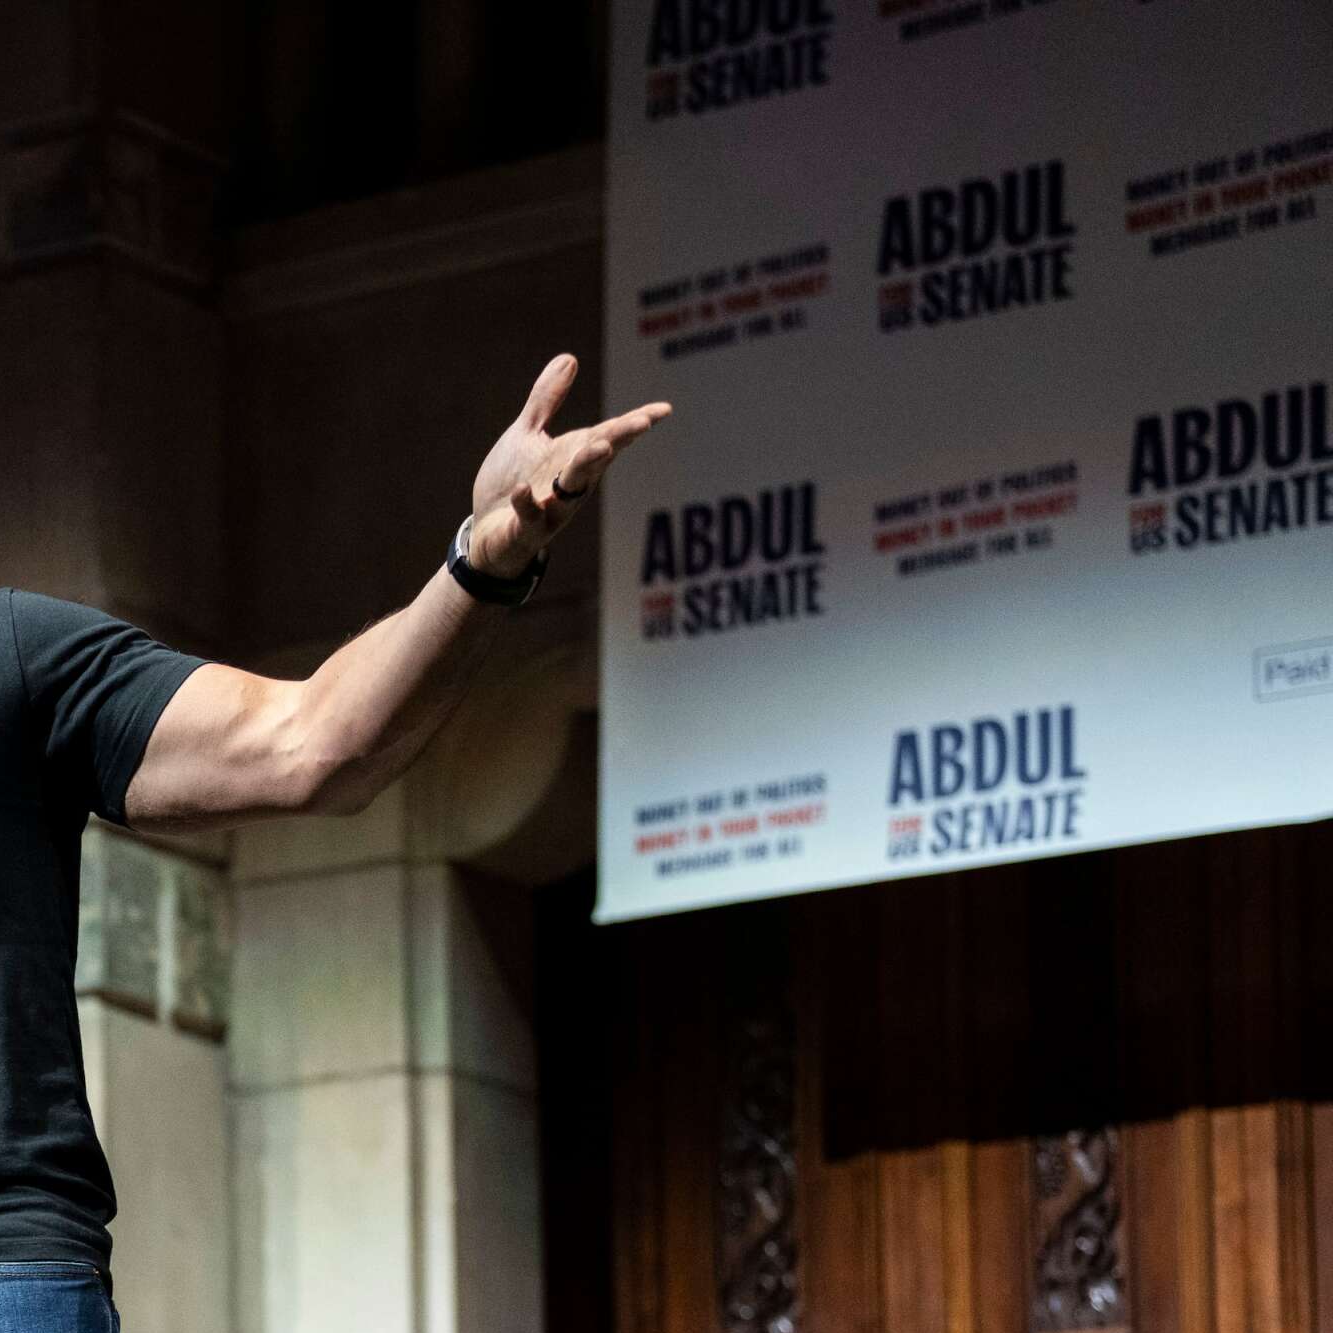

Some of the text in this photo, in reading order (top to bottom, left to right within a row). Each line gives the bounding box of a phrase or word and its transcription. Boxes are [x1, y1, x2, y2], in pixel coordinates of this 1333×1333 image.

[878, 160, 1075, 273] ABDUL
[920, 244, 1071, 325] SENATE
[1128, 383, 1333, 494] ABDUL
[642, 483, 823, 583] ABDUL
[1176, 471, 1333, 547] SENATE
[684, 564, 820, 636] SENATE
[1265, 650, 1331, 684] Paid
[887, 705, 1087, 807] ABDUL
[931, 788, 1082, 854] SENATE
